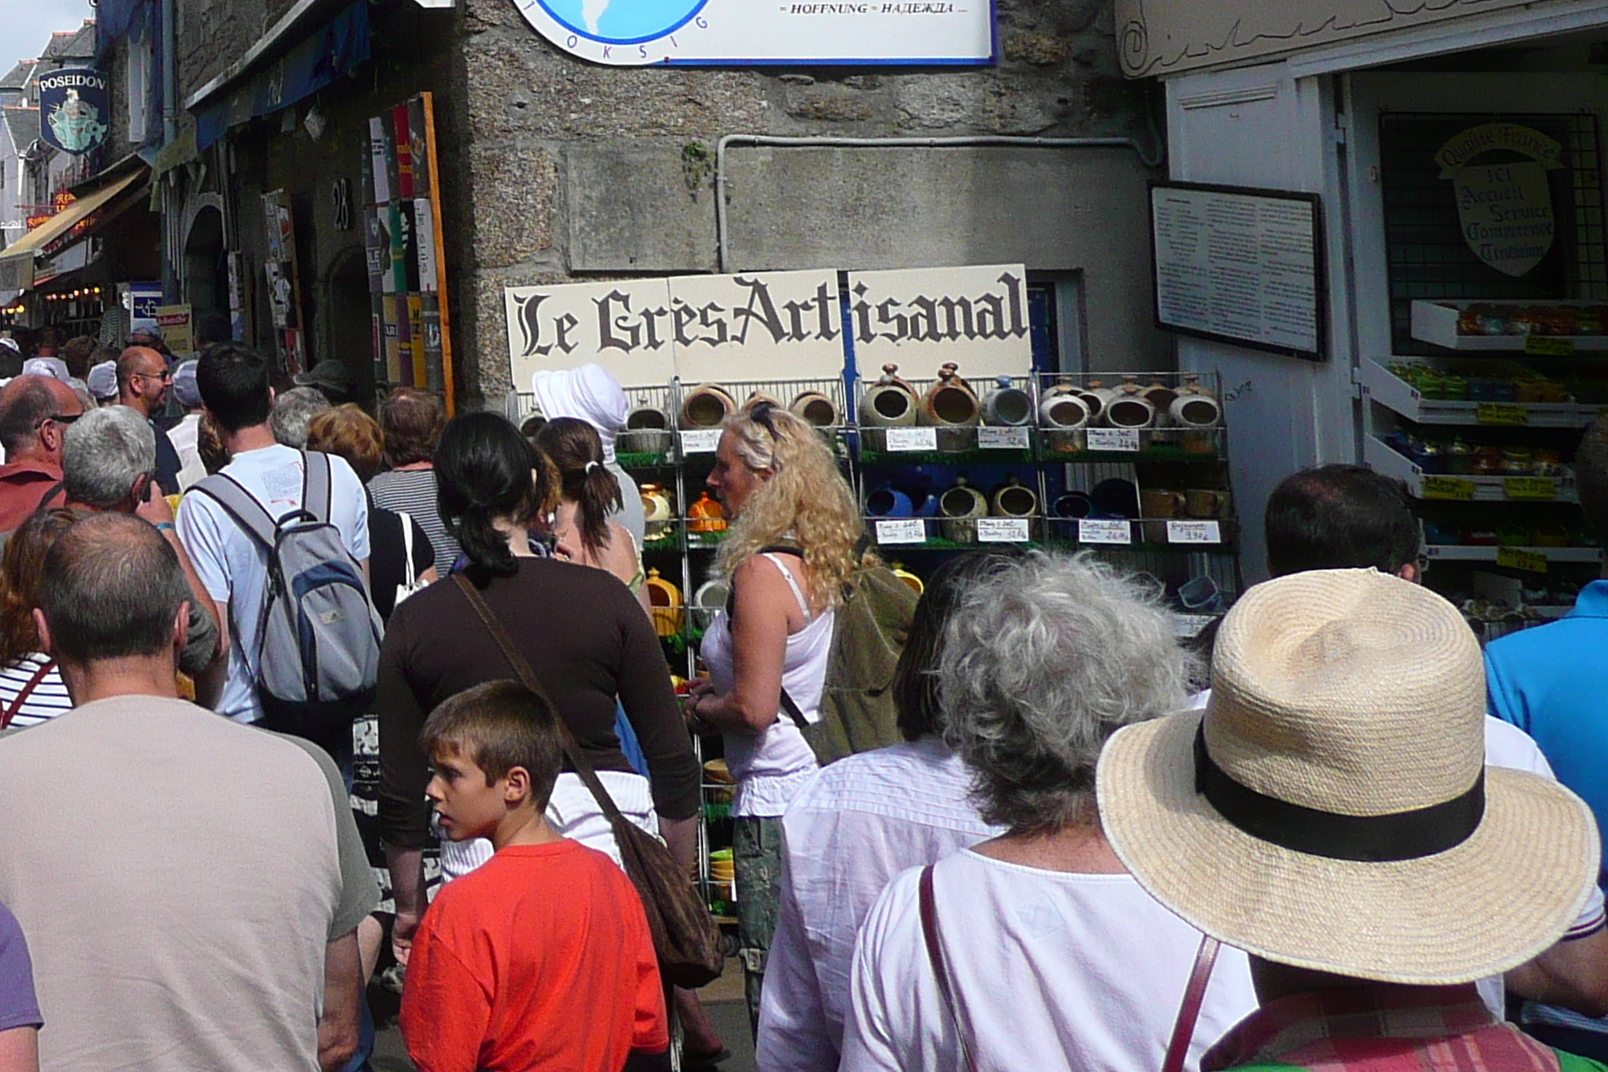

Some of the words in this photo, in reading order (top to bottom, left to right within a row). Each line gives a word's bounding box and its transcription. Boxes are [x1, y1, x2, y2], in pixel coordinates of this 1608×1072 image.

[790, 3, 868, 15] HOFFNUNG
[40, 74, 106, 92] POSEIDON
[512, 292, 580, 357] Le
[591, 289, 729, 355] Grès
